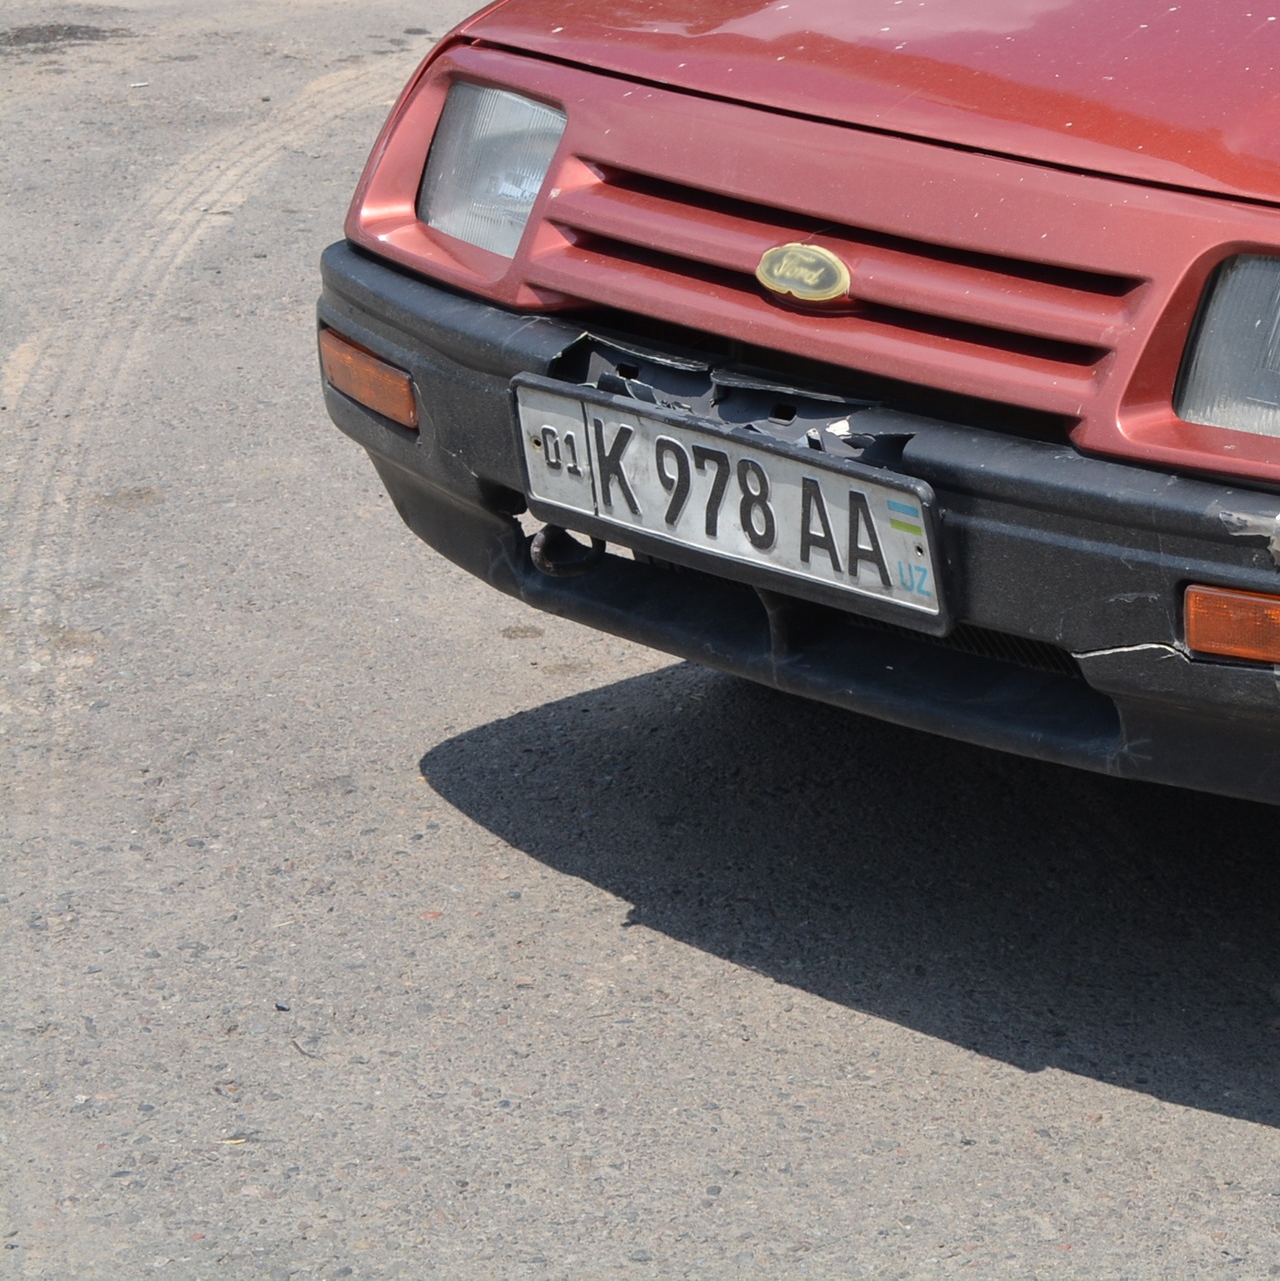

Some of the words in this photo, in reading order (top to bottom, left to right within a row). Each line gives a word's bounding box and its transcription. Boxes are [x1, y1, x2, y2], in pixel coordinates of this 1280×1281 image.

[774, 250, 826, 286] Ford
[539, 424, 582, 478] 01
[655, 435, 778, 552] 978
[800, 476, 893, 588] AA
[898, 560, 932, 598] UZ
